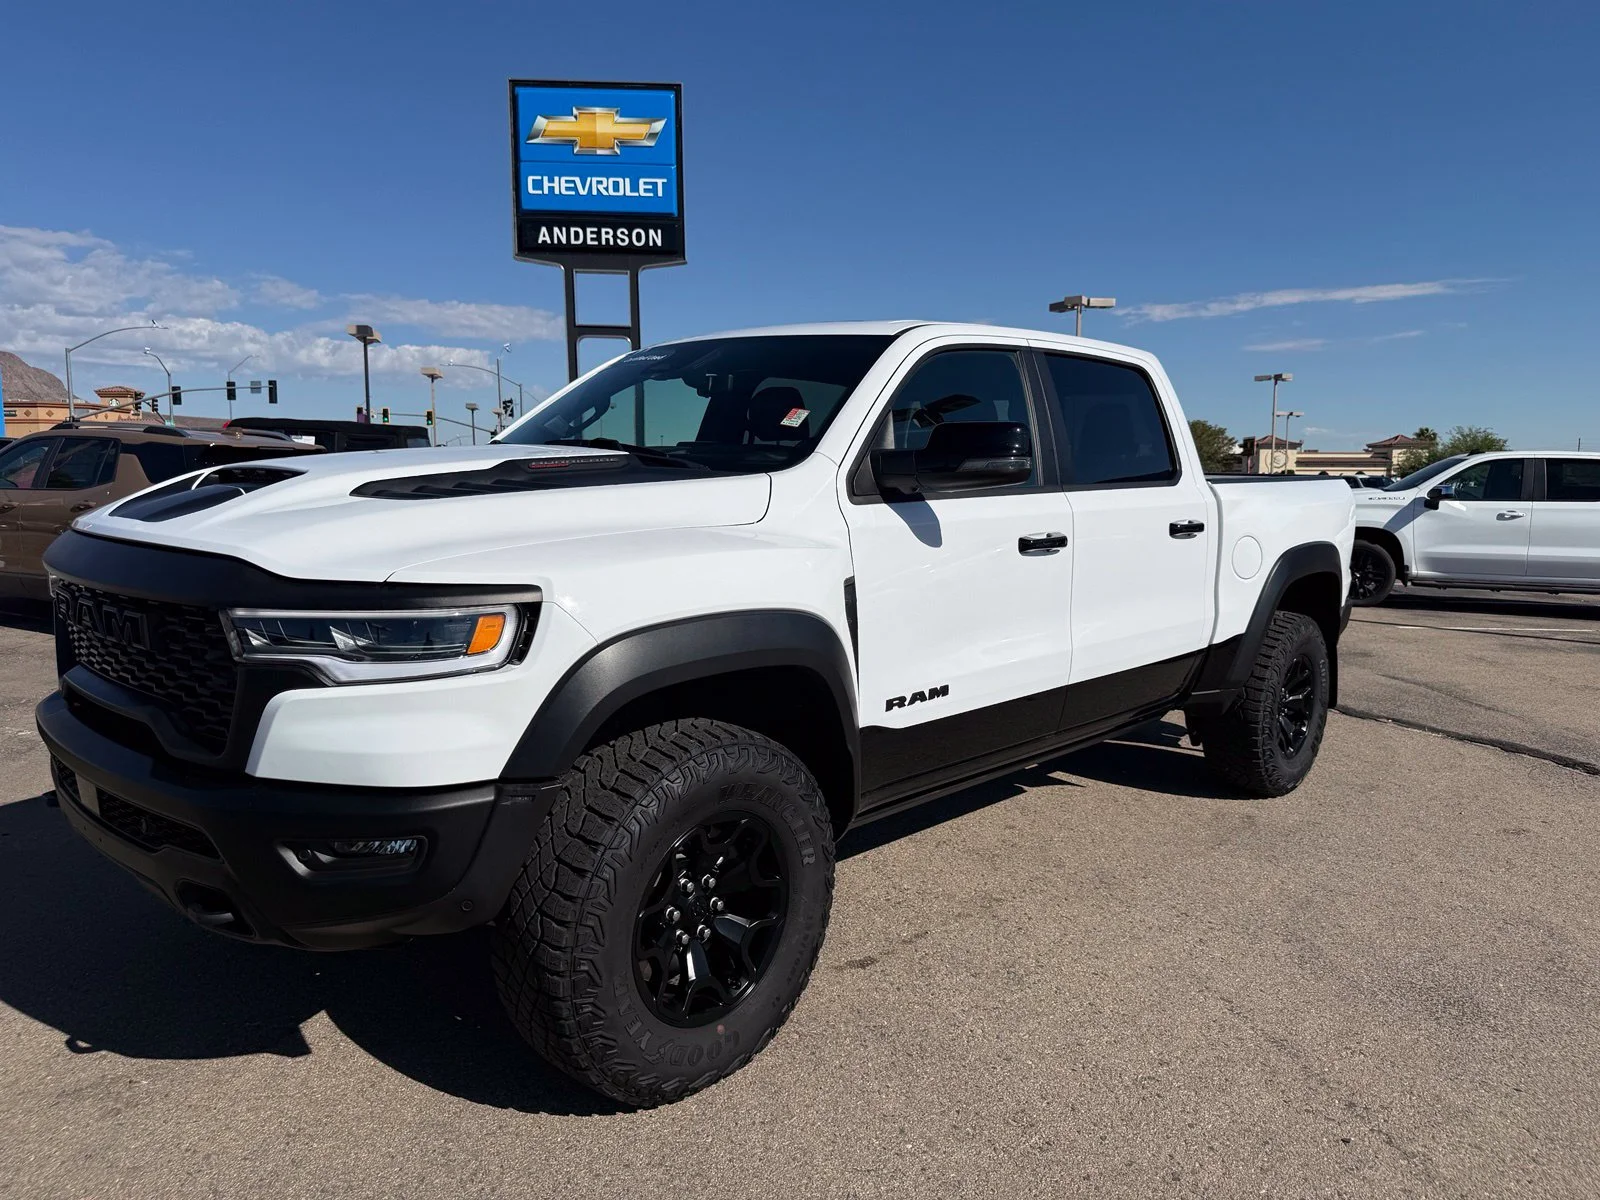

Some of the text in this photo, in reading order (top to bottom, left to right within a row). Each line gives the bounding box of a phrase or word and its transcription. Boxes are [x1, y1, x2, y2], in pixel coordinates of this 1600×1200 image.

[527, 175, 667, 197] CHEVROLET
[537, 226, 662, 247] ANDERSON
[55, 586, 150, 651] RAM
[885, 684, 949, 712] RAM
